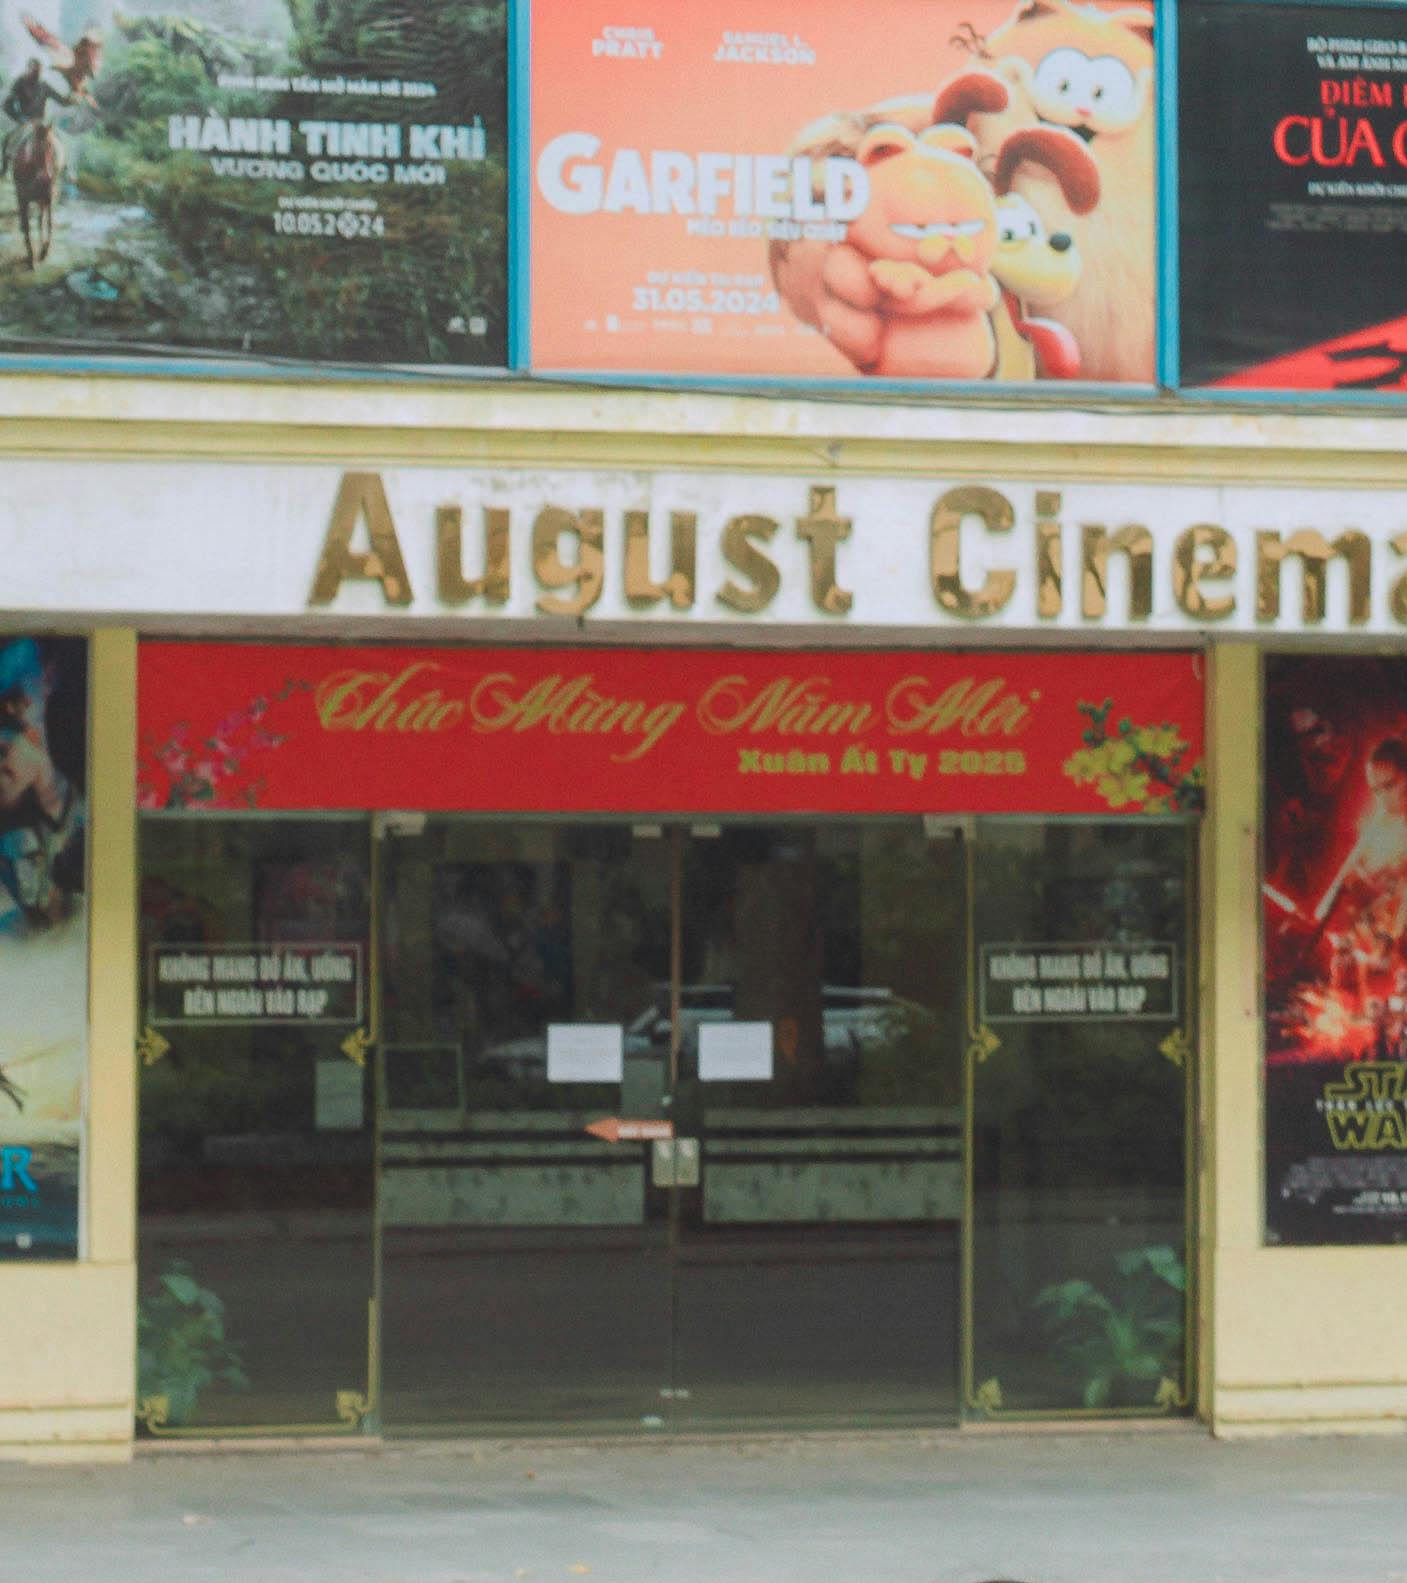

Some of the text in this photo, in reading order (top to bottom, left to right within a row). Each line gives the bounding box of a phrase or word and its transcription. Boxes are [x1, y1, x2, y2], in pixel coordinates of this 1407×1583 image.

[592, 39, 663, 60] PRATT
[713, 45, 816, 66] JACKSON
[168, 107, 292, 154] HÀNH
[298, 120, 403, 157] TINH
[1273, 106, 1386, 168] CỦA
[310, 159, 389, 184] QUỐC
[537, 131, 870, 222] GARFIELD
[308, 471, 854, 615] August
[315, 661, 1042, 763] Chúc Mừng Năm Mới
[738, 748, 830, 774] Xuân
[938, 749, 1026, 774] 2025
